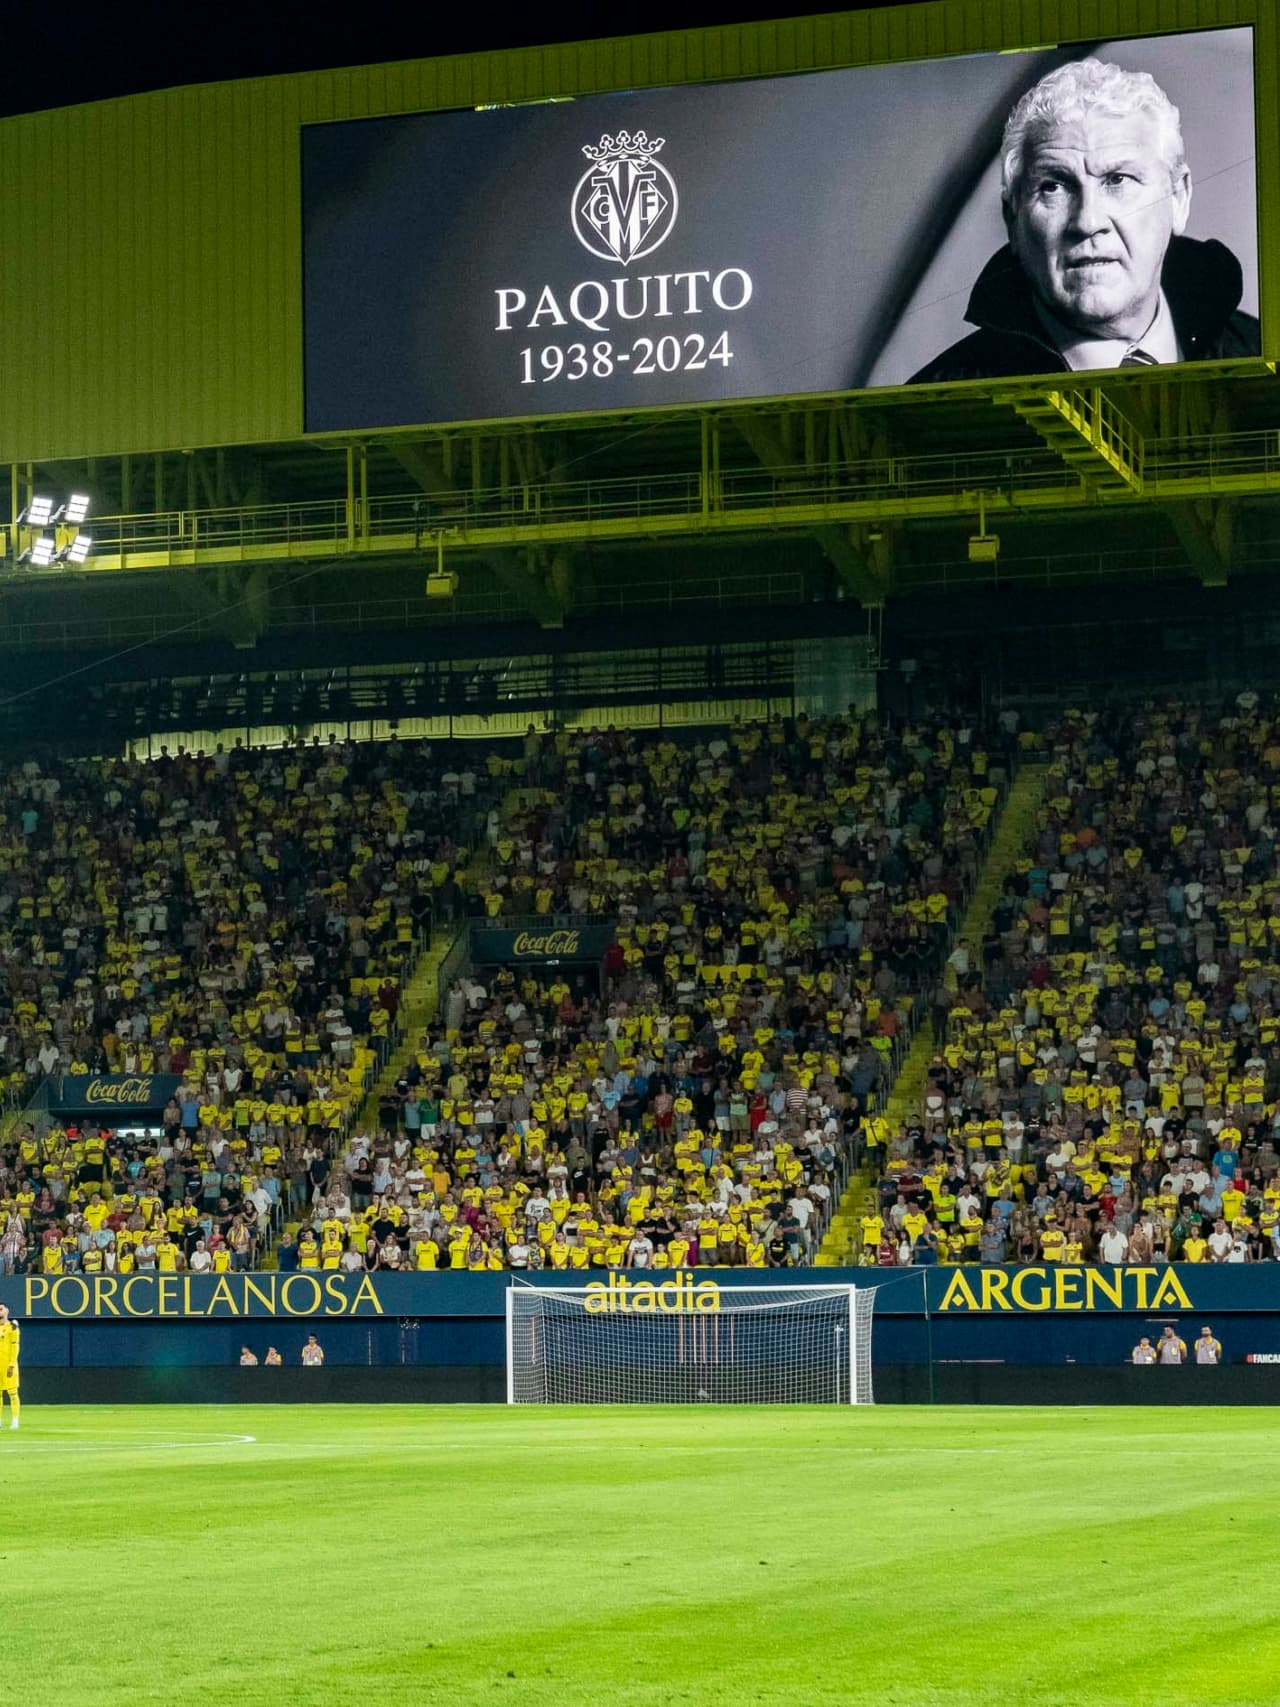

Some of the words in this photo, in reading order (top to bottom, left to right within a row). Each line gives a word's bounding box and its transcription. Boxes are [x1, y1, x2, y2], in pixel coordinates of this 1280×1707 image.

[494, 268, 753, 332] PAQUITO
[520, 331, 734, 384] 1938-2024
[513, 930, 580, 956] Coca-Cola
[86, 1078, 152, 1103] Coca-Cola
[24, 1274, 384, 1317] PORCELANOSA
[583, 1270, 720, 1314] altadia
[938, 1265, 1194, 1311] ARGENTA
